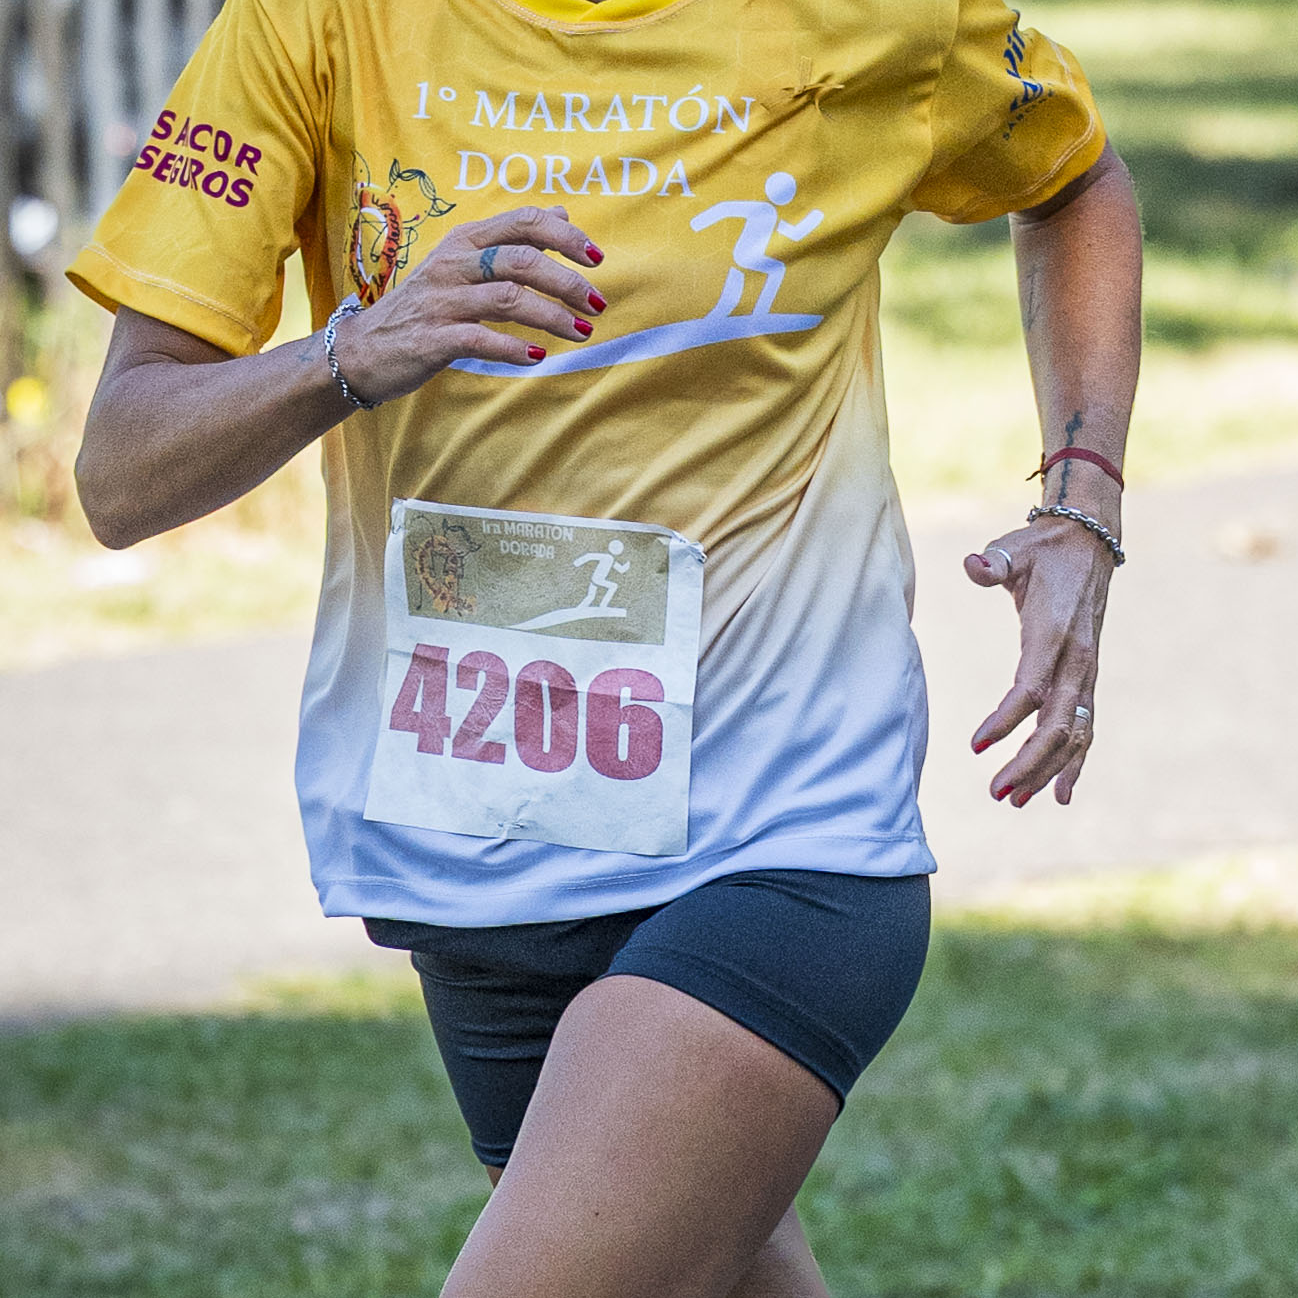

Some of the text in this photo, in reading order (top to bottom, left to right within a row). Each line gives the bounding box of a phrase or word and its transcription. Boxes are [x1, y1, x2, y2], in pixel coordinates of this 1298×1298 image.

[469, 84, 756, 134] MARATÓN
[150, 109, 262, 177] SACOR
[134, 144, 255, 208] SEGUROS
[454, 150, 696, 197] DORADA
[500, 539, 556, 560] DORADA
[389, 643, 665, 781] 4206
